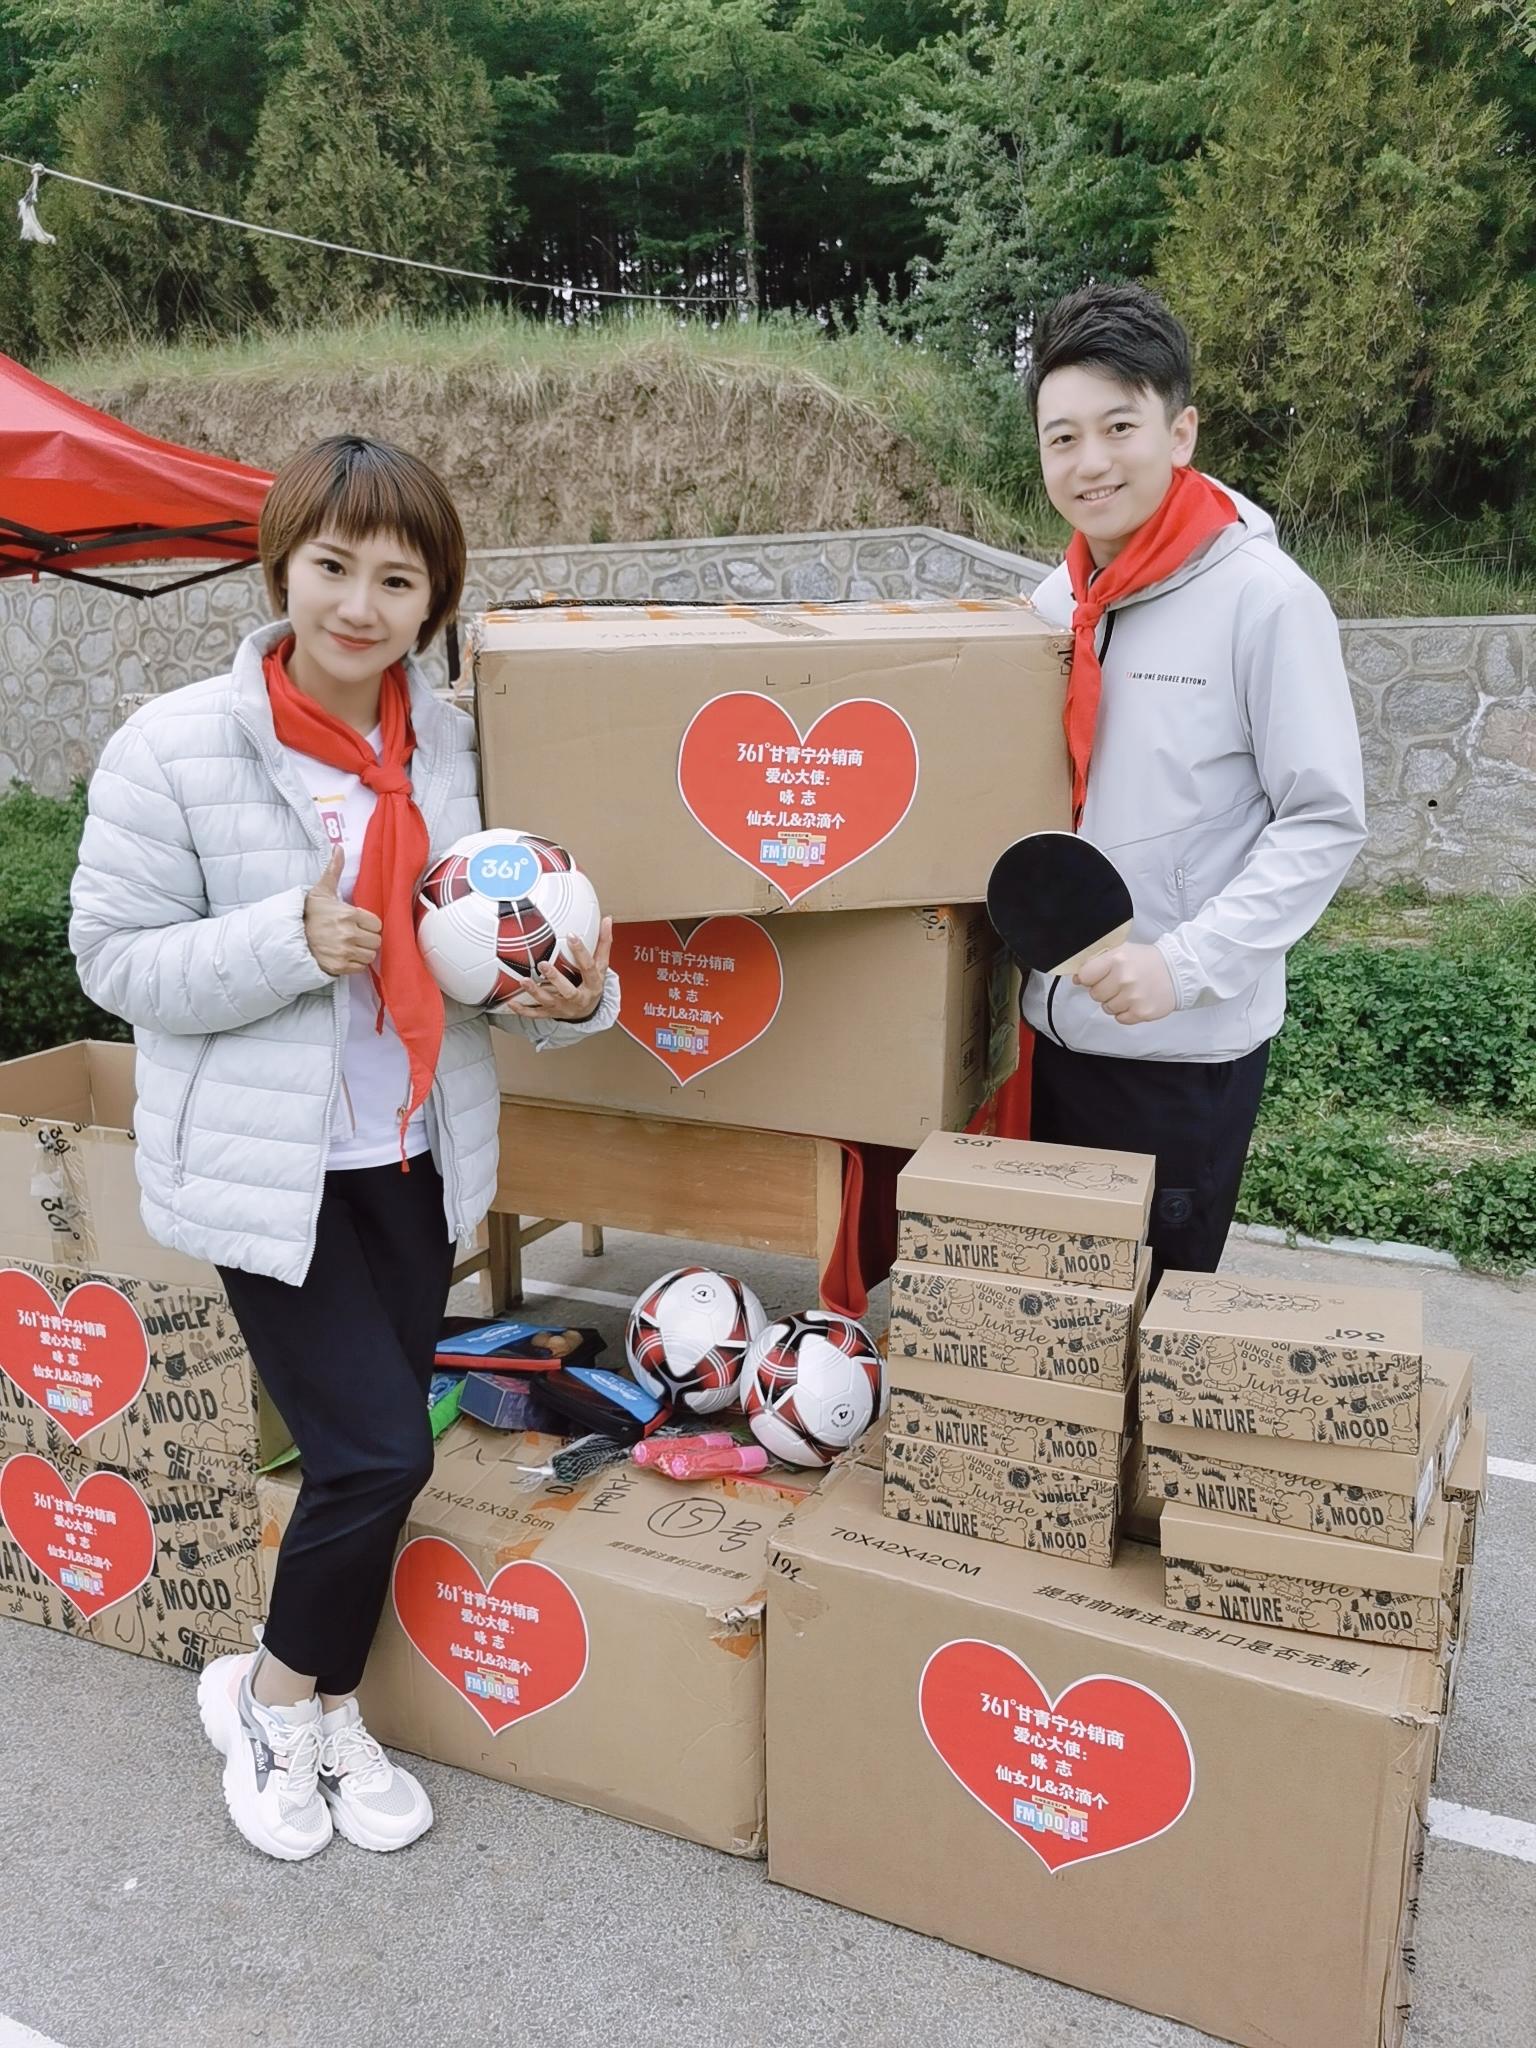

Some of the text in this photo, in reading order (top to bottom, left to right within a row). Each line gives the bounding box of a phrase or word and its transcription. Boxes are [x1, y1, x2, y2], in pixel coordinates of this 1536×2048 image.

[1156, 674, 1179, 683] DEGREE
[1180, 676, 1206, 686] BEYOND
[746, 810, 845, 829] 仙女儿&尕滴个
[762, 844, 819, 860] FM100.8
[481, 857, 529, 881] 361°
[953, 1137, 1000, 1147] 361°
[41, 1197, 80, 1240] 361°
[944, 1244, 999, 1267] NATURE
[1064, 1254, 1111, 1273] MOOD
[976, 1282, 1015, 1306] JUNGLE
[978, 1292, 1004, 1309] BOYS
[145, 1310, 210, 1336] UNGLE
[979, 1313, 1048, 1344] Jungle
[1052, 1315, 1102, 1329] JUNGLE
[934, 1342, 988, 1367] NATURE
[1182, 1333, 1201, 1360] YOU?
[1237, 1340, 1284, 1364] JUNGLE
[186, 1360, 214, 1380] FREE
[1053, 1357, 1100, 1376] MOOD
[1240, 1350, 1270, 1368] BOYS
[1244, 1373, 1328, 1406] Jungle
[1329, 1371, 1388, 1388] JUNGLE
[146, 1388, 219, 1424] MOOD
[1367, 1402, 1388, 1413] FREE
[1192, 1408, 1257, 1433] NATURE
[1333, 1418, 1389, 1440] MOOD
[935, 1420, 988, 1447] NATURE
[164, 1440, 195, 1467] GET
[1052, 1440, 1097, 1457] MOOD
[966, 1455, 1003, 1479] JUNGLE
[968, 1464, 993, 1481] BOYS
[424, 1487, 554, 1530] 74X42.5X33.5cm
[969, 1484, 1039, 1517] Jungle
[1040, 1491, 1088, 1503] JUNGLE
[1196, 1483, 1257, 1512] NATURE
[926, 1509, 978, 1537] NATURE
[1330, 1507, 1384, 1525] MOOD
[831, 1526, 981, 1577] 70X42X42CM
[1042, 1532, 1087, 1549] MOOD
[199, 1551, 226, 1569] FREE
[160, 1578, 231, 1611] MOOD
[1392, 1593, 1413, 1606] FREE
[1220, 1595, 1283, 1622] NATURE
[1358, 1610, 1413, 1631] MOOD
[178, 1626, 208, 1653] GET
[1033, 1584, 1371, 1678] 提货前请注意封口是否完整！
[980, 1692, 1125, 1750] 361°甘青宁分销商
[1013, 1725, 1087, 1761] 爱心大使：
[995, 1764, 1109, 1810] 仙女儿&尕滴个
[1015, 1804, 1082, 1836] FM100.8
